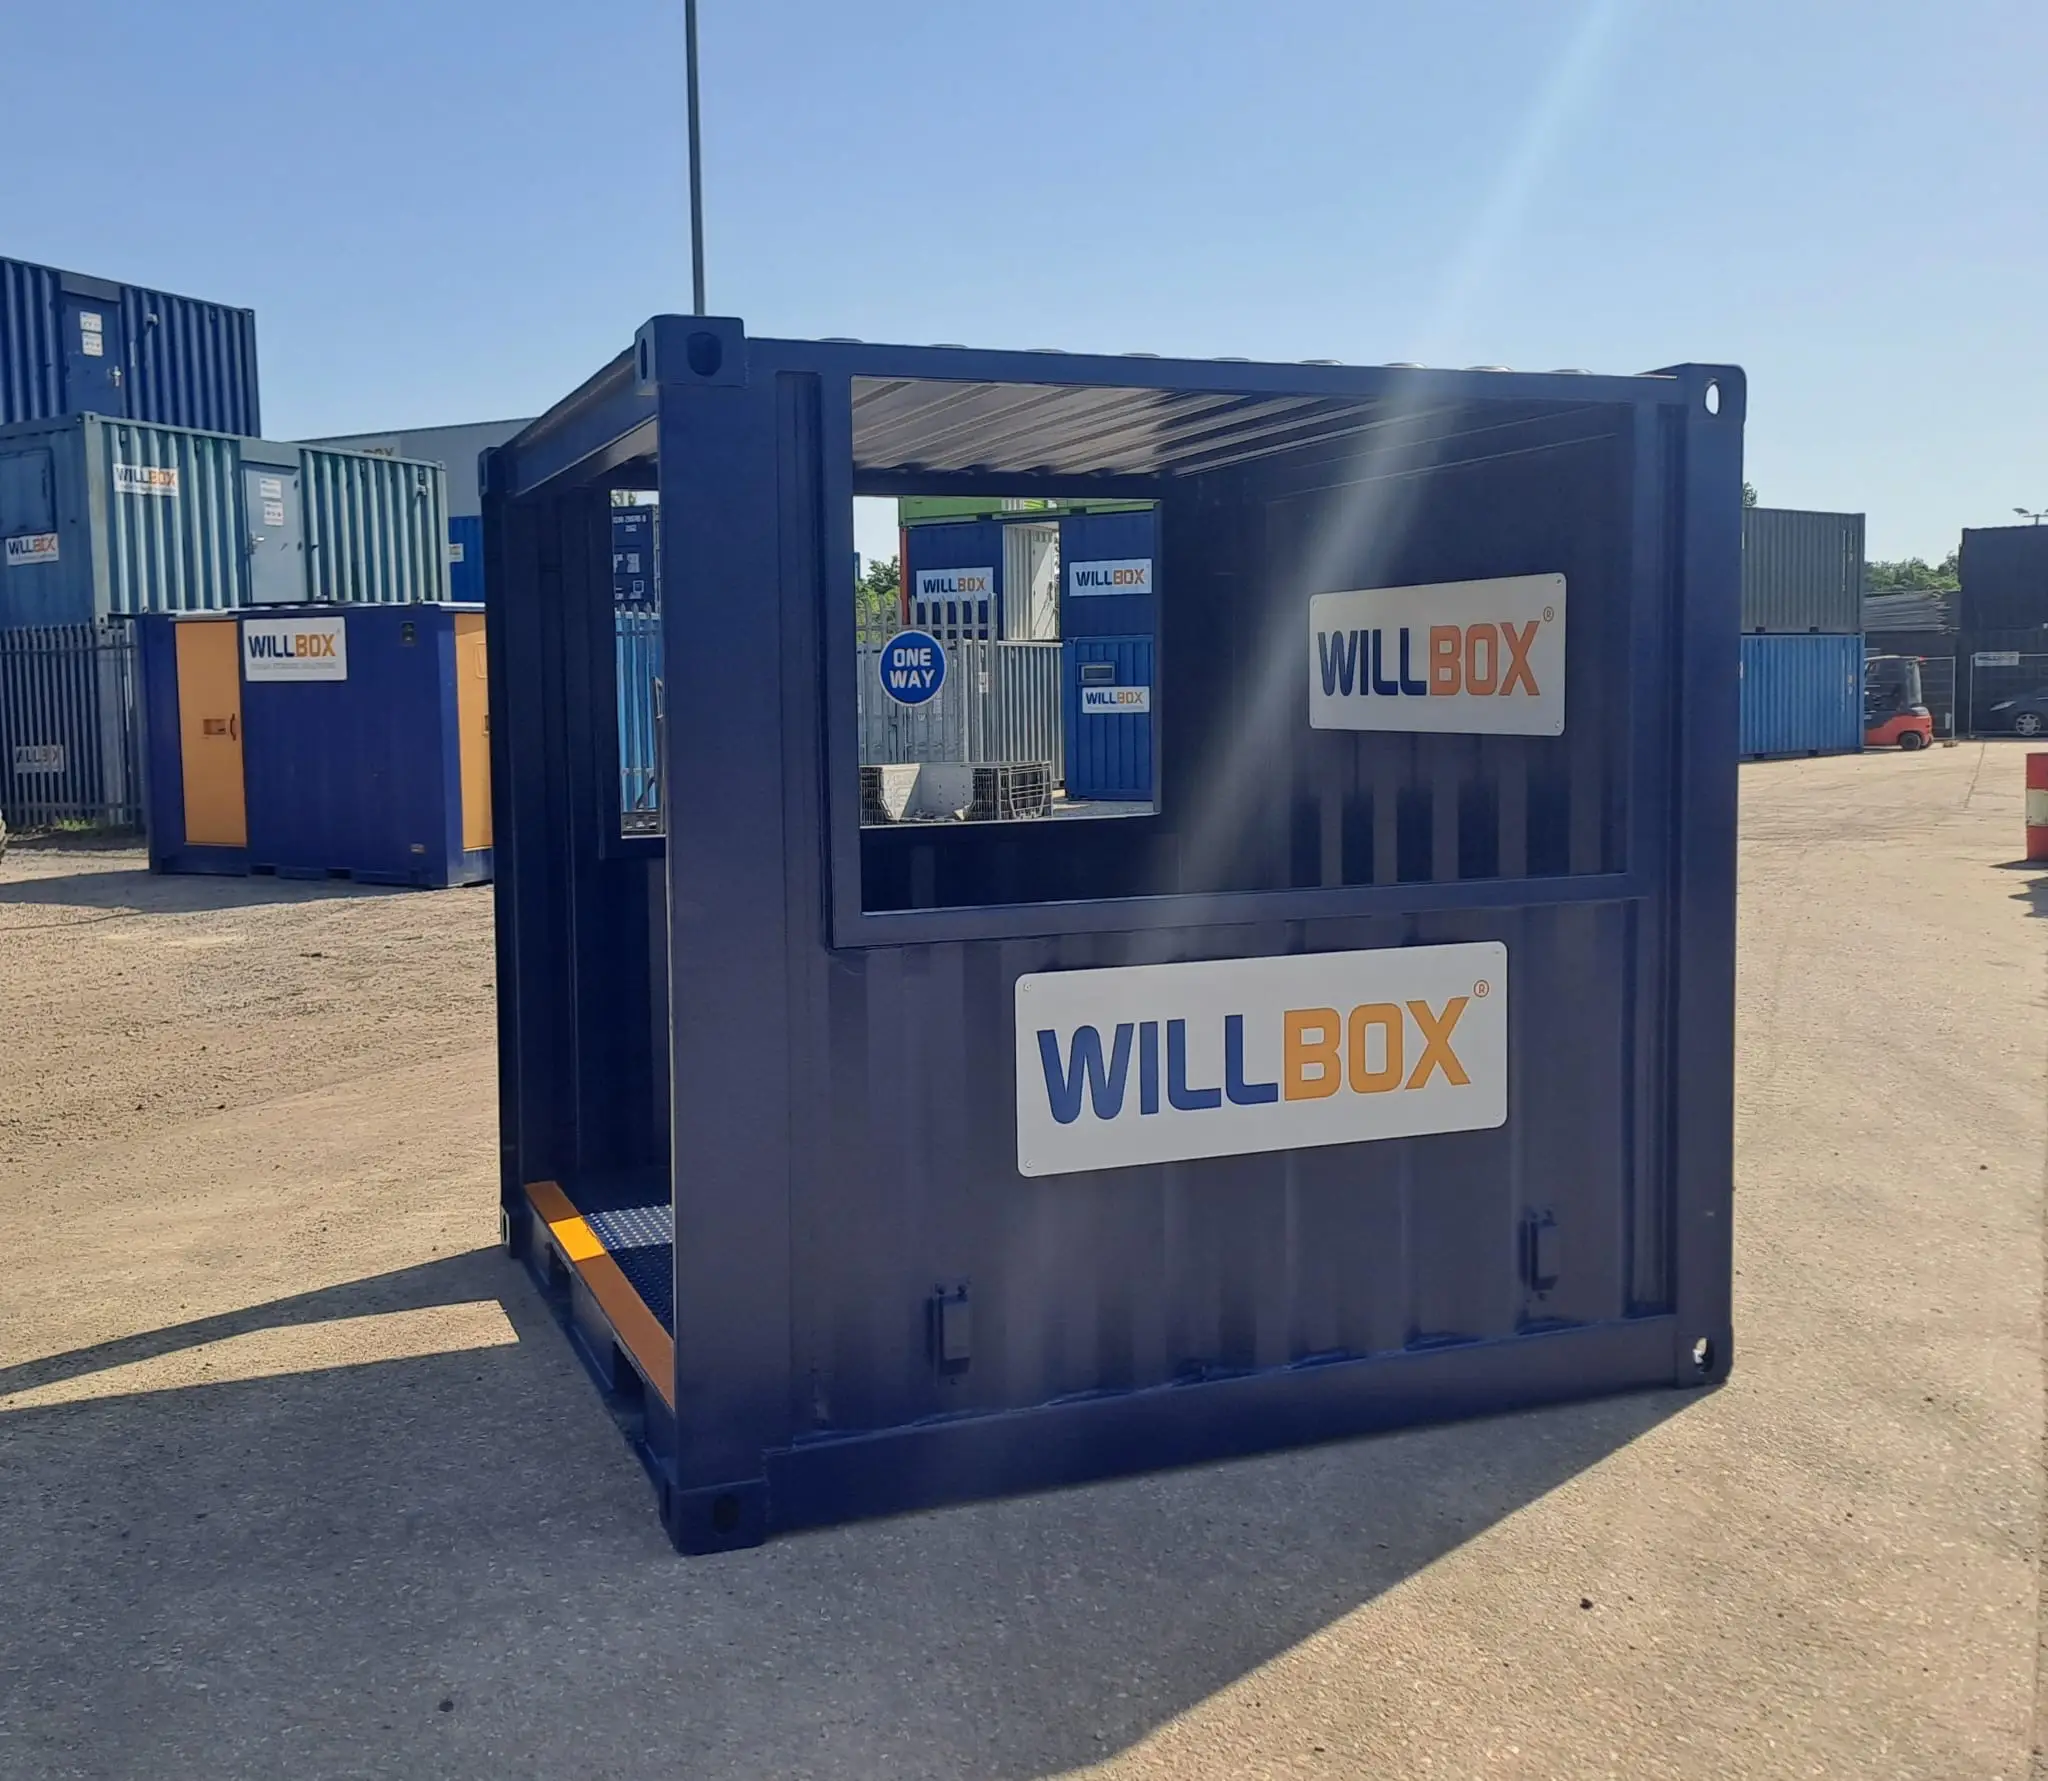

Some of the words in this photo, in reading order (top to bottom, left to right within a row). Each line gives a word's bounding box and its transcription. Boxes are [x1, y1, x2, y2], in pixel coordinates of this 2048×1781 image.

[923, 577, 987, 593] WILLBOX
[1075, 568, 1145, 587] WILLBOX
[248, 633, 336, 658] WILLBOX
[893, 648, 931, 667] ONE
[1316, 620, 1541, 697] WILLBOX
[889, 669, 935, 689] WAY
[1085, 691, 1144, 705] WILLBOX
[1036, 996, 1471, 1125] WILLBOX
